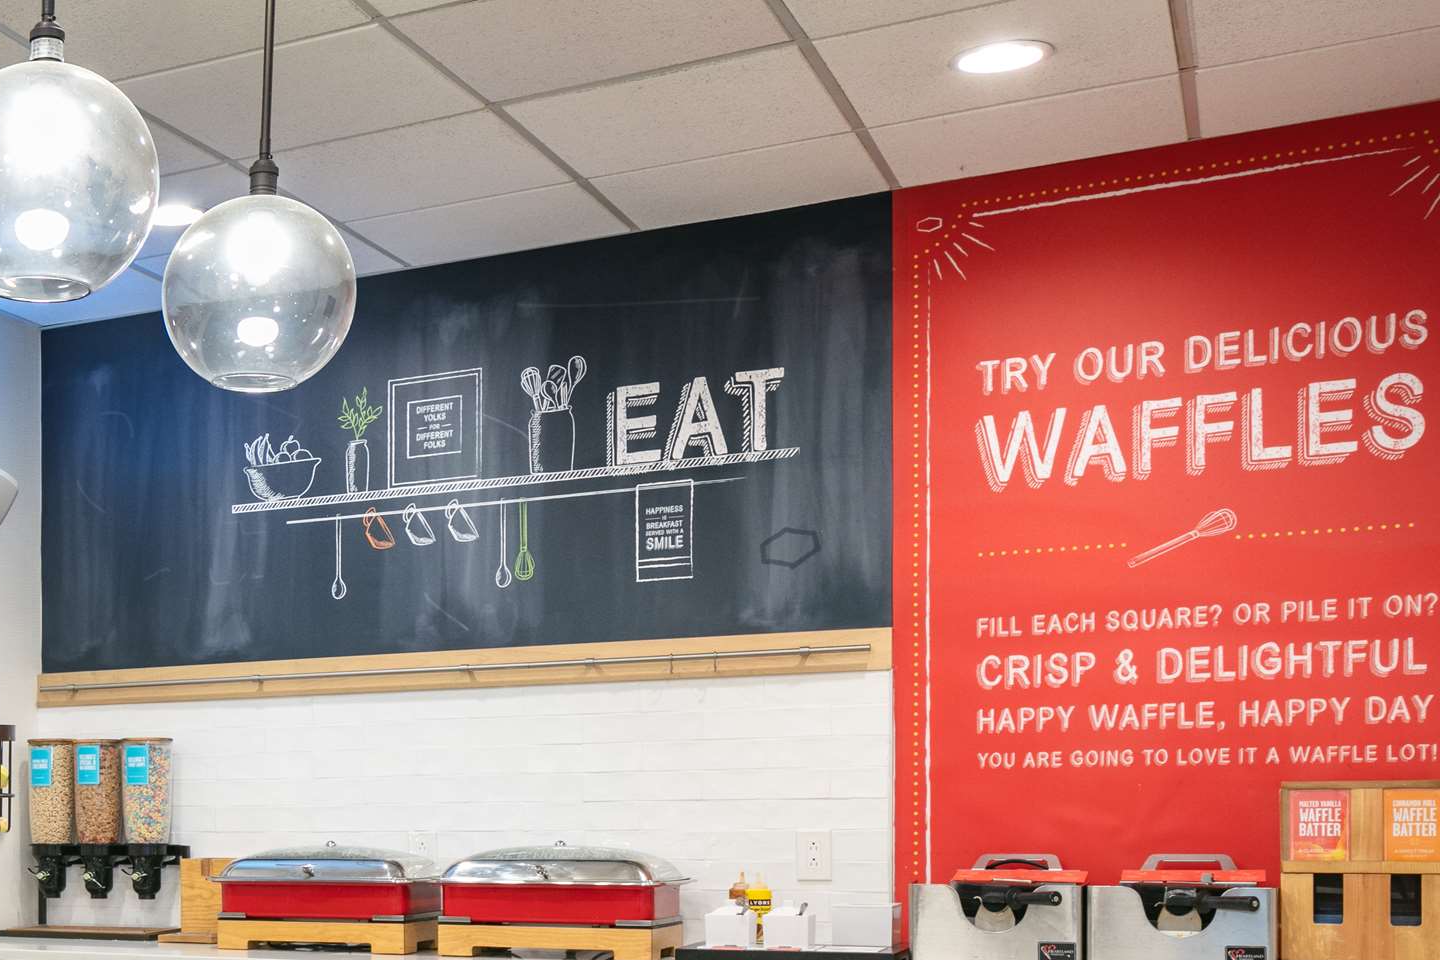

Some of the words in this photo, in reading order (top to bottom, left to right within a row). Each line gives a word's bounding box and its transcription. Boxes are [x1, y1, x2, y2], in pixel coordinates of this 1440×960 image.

[975, 352, 1056, 395] TRY
[1073, 340, 1166, 386] OUR
[1184, 309, 1429, 374] DELICIOUS
[416, 402, 453, 414] DIFFERENT
[424, 412, 446, 421] YOLKS
[606, 367, 785, 467] EAT
[416, 430, 453, 441] DIFFERENT
[974, 372, 1427, 494] WAFFLES
[424, 440, 446, 449] FOLKS
[646, 505, 683, 515] HAPPINESS
[646, 520, 683, 530] BREAKFAST
[646, 535, 684, 551] SMILE
[976, 616, 1022, 639] FILL
[1031, 611, 1096, 636] EACH
[1105, 604, 1223, 633] SQUARE?
[1232, 602, 1271, 626] OR
[1280, 598, 1338, 623] PILE
[1347, 596, 1373, 620] IT
[1383, 592, 1438, 617] ON?
[976, 650, 1097, 690] CRISP
[1113, 647, 1139, 685] &
[1156, 637, 1428, 684] DELIGHTFUL
[976, 704, 1075, 734] HAPPY
[1088, 701, 1226, 732] WAFFLE,
[1239, 697, 1351, 728] HAPPY
[1364, 694, 1434, 725] DAY
[976, 752, 1016, 770] YOU
[1022, 751, 1063, 769] ARE
[1070, 749, 1135, 768] GOING
[1142, 748, 1169, 766] TO
[1176, 747, 1231, 766] LOVE
[1239, 746, 1258, 765] IT
[1264, 746, 1280, 765] A
[1288, 743, 1378, 764] WAFFLE
[1386, 742, 1438, 763] LOT!
[1298, 807, 1342, 822] WAFFLE
[1393, 807, 1437, 822] WAFFLE
[1298, 822, 1342, 837] BATTER
[1392, 822, 1437, 837] BATTER
